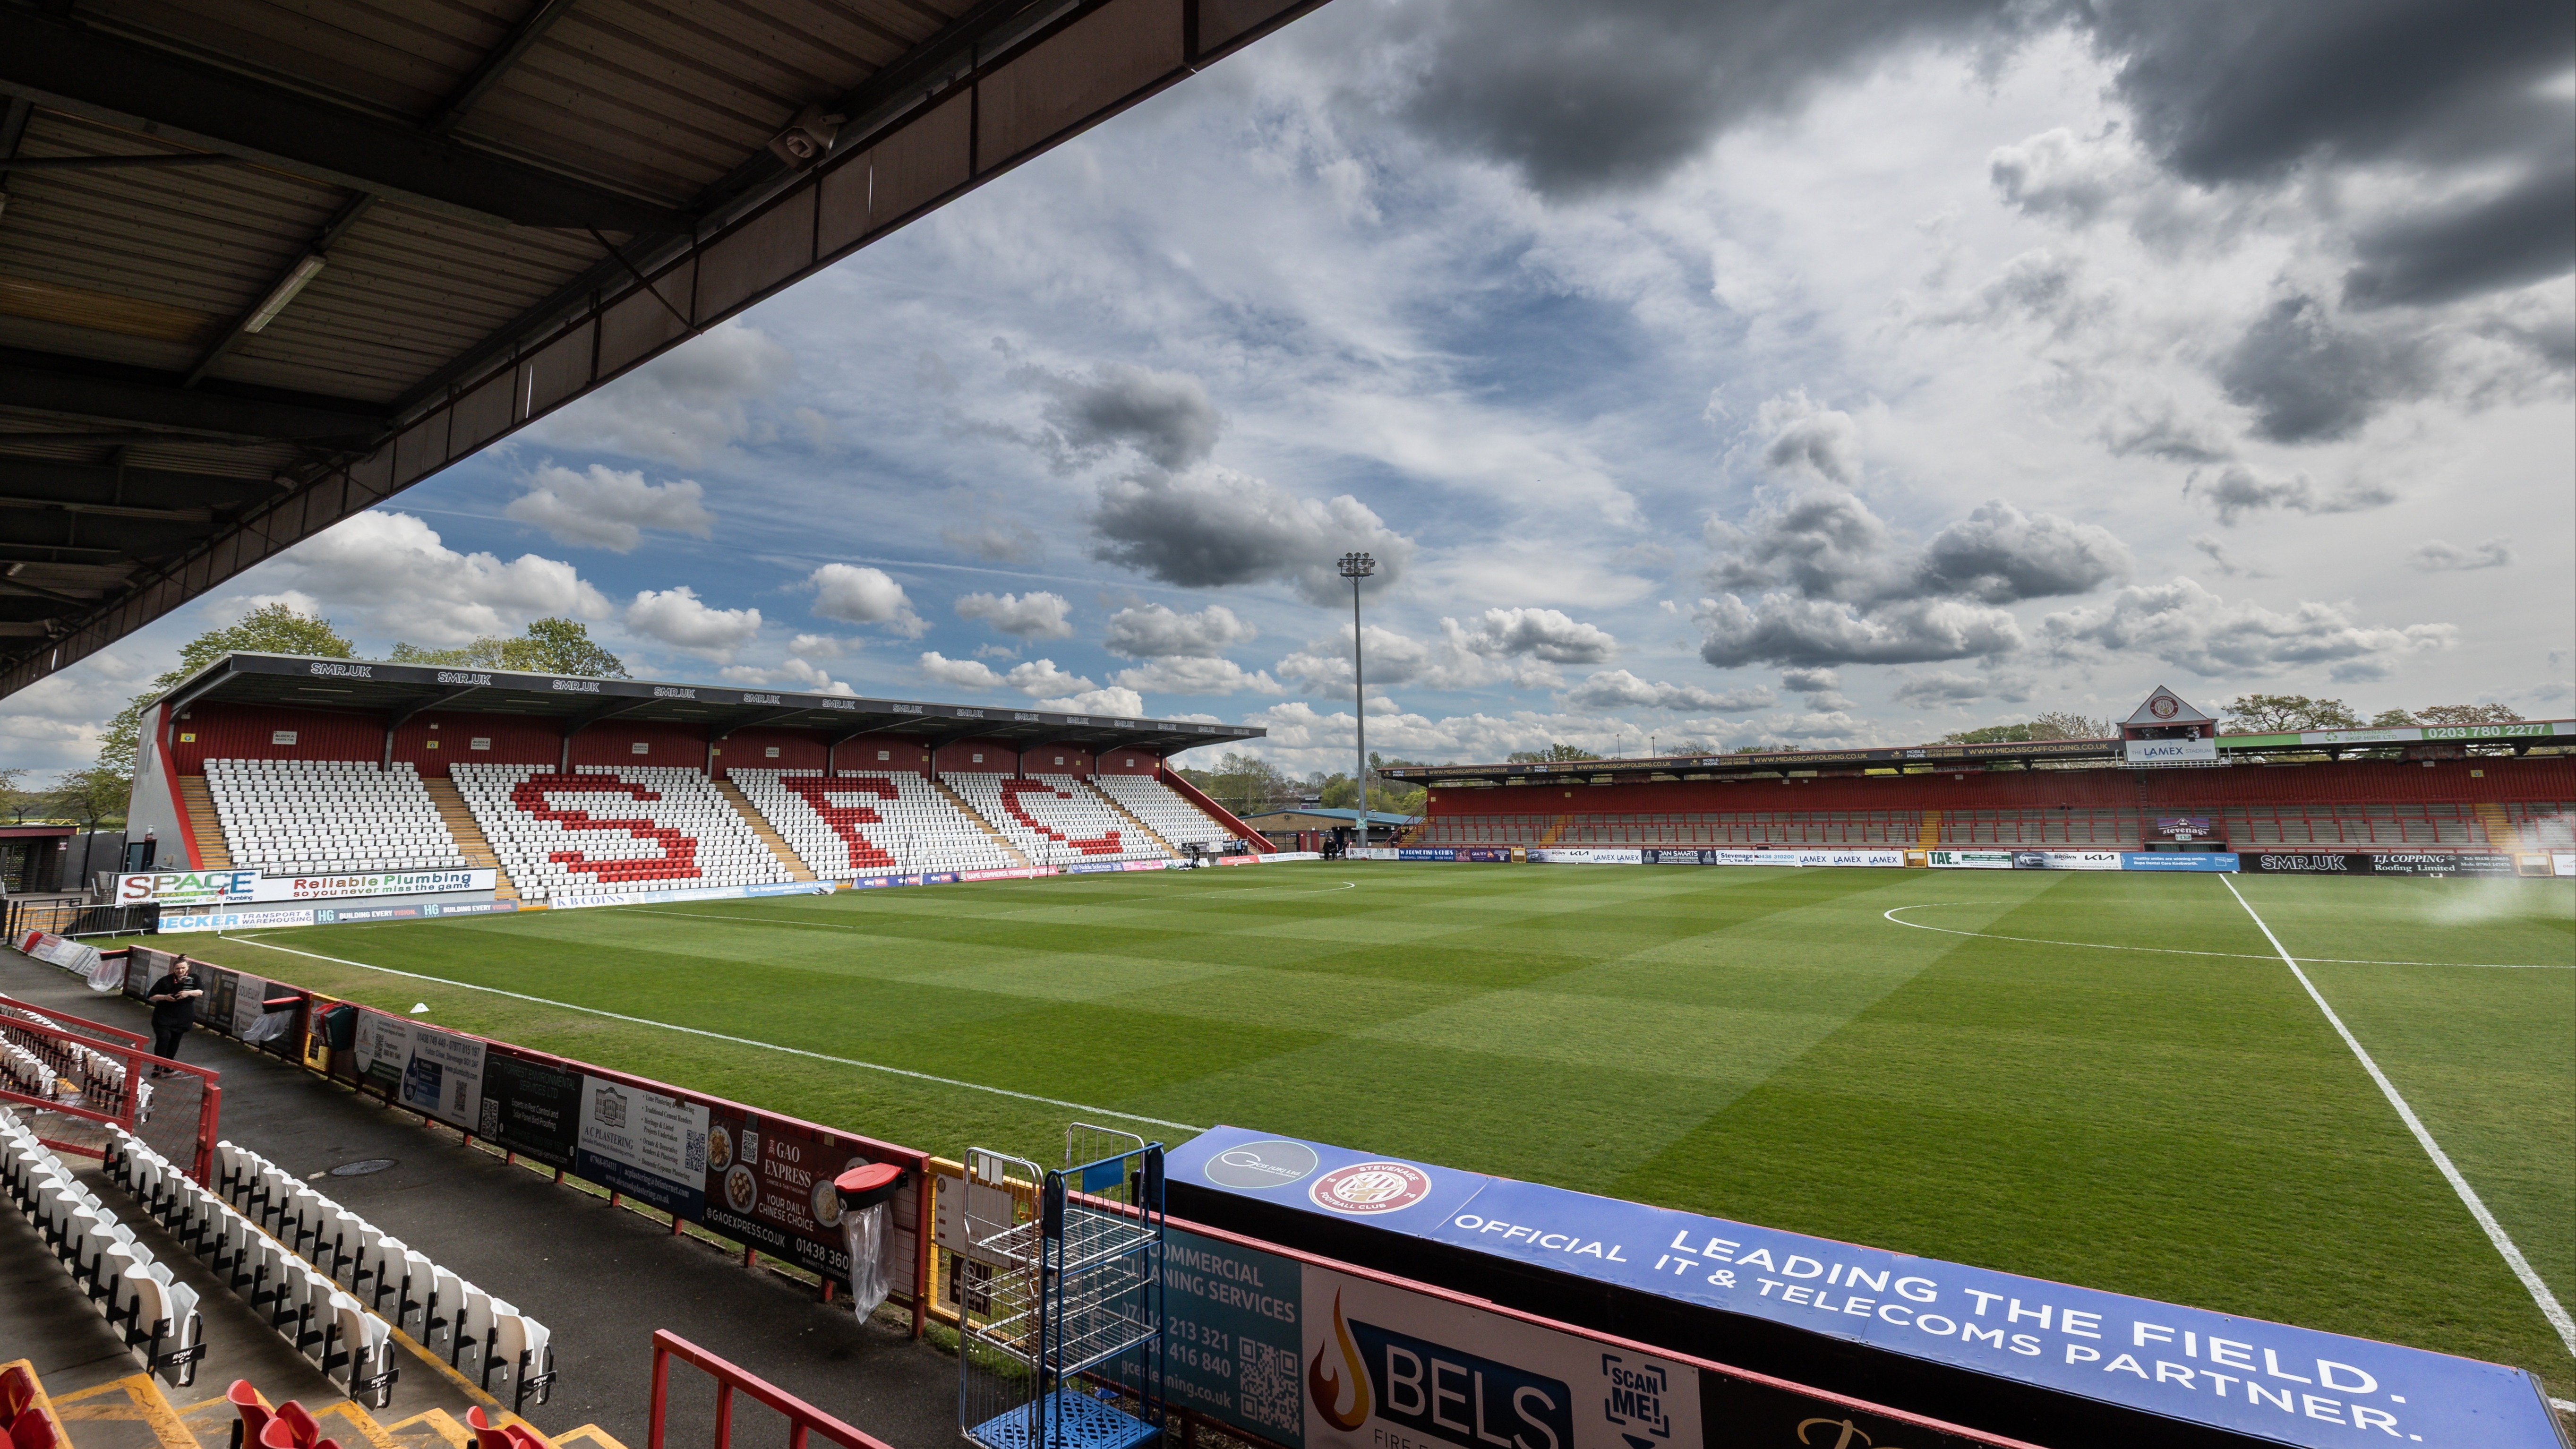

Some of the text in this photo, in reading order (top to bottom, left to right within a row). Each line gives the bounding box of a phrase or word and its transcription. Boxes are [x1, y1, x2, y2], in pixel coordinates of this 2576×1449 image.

[310, 663, 372, 677] SMR.UK
[437, 672, 491, 685] SMR.UK
[552, 679, 599, 692] SMR.UK
[2428, 724, 2546, 738] 0203 780 2277
[1968, 743, 2108, 755] WWW.MIDASSCAFFOLDING.CO.UK
[2144, 747, 2183, 756] LAMEX
[2162, 827, 2208, 835] stevenage
[1929, 852, 1952, 865] TAE
[2260, 855, 2347, 870] SMR.UK
[2373, 855, 2445, 863] T.J. COPPING
[983, 870, 1008, 878] COMMERCE
[1009, 868, 1030, 876] POWERED
[2375, 864, 2413, 873] Roofing
[123, 872, 256, 900] SPACE
[294, 873, 471, 889] Reliable Plumbing
[760, 883, 795, 892] Supermarket
[313, 889, 337, 898] you
[341, 886, 379, 895] never
[383, 885, 411, 893] miss
[438, 882, 470, 892] game
[557, 895, 625, 907] K B COINS
[158, 914, 239, 929] BECKER
[242, 911, 302, 919] TRANSPORT
[242, 916, 312, 925] WAREHOUSING
[318, 909, 334, 922] HG
[339, 911, 370, 919] BUILDING
[504, 1063, 576, 1090] FORREST ENVIRONMENTAL
[520, 1080, 558, 1099] SERVICES LTD
[512, 1098, 524, 1109] Experts
[528, 1103, 536, 1112] Pest
[536, 1106, 551, 1115] Control
[551, 1110, 559, 1119] and
[522, 1112, 531, 1123] Panel
[539, 1117, 556, 1132] Proofing
[584, 1126, 633, 1150] A C PLASTERING
[777, 1142, 800, 1163] GAO
[764, 1159, 811, 1188] EXPRESS
[1359, 1165, 1419, 1181] STEVENAGE
[624, 1168, 689, 1198] acplastering@btinternet.com
[766, 1178, 779, 1187] CHINESE
[790, 1186, 807, 1196] TAKEAWAY
[767, 1193, 805, 1217] YOUR DAILY
[1320, 1192, 1355, 1209] FOOTBALL
[758, 1202, 814, 1232] CHINESE CHOICE
[712, 1209, 785, 1248] GAOEXPRESS.CO.UK
[1455, 1214, 1627, 1262] OFFICIAL
[796, 1237, 825, 1261] 01438
[1148, 1243, 1263, 1287] COMMERCIAL
[1209, 1280, 1295, 1323] SERVICES
[1671, 1229, 2406, 1404] LEADING THE FIELD.
[1169, 1317, 1229, 1352] 213 321
[172, 1349, 193, 1360] ROW
[1654, 1253, 2423, 1442] IT & TELECOMS PARTNER.
[1169, 1343, 1231, 1378] 416 840
[371, 1374, 388, 1384] ROW
[533, 1375, 548, 1385] ROW
[1612, 1366, 1659, 1396] SCAN
[1386, 1344, 1559, 1449] BELS
[1612, 1387, 1660, 1425] ME!
[1375, 1428, 1411, 1449] FIRE
